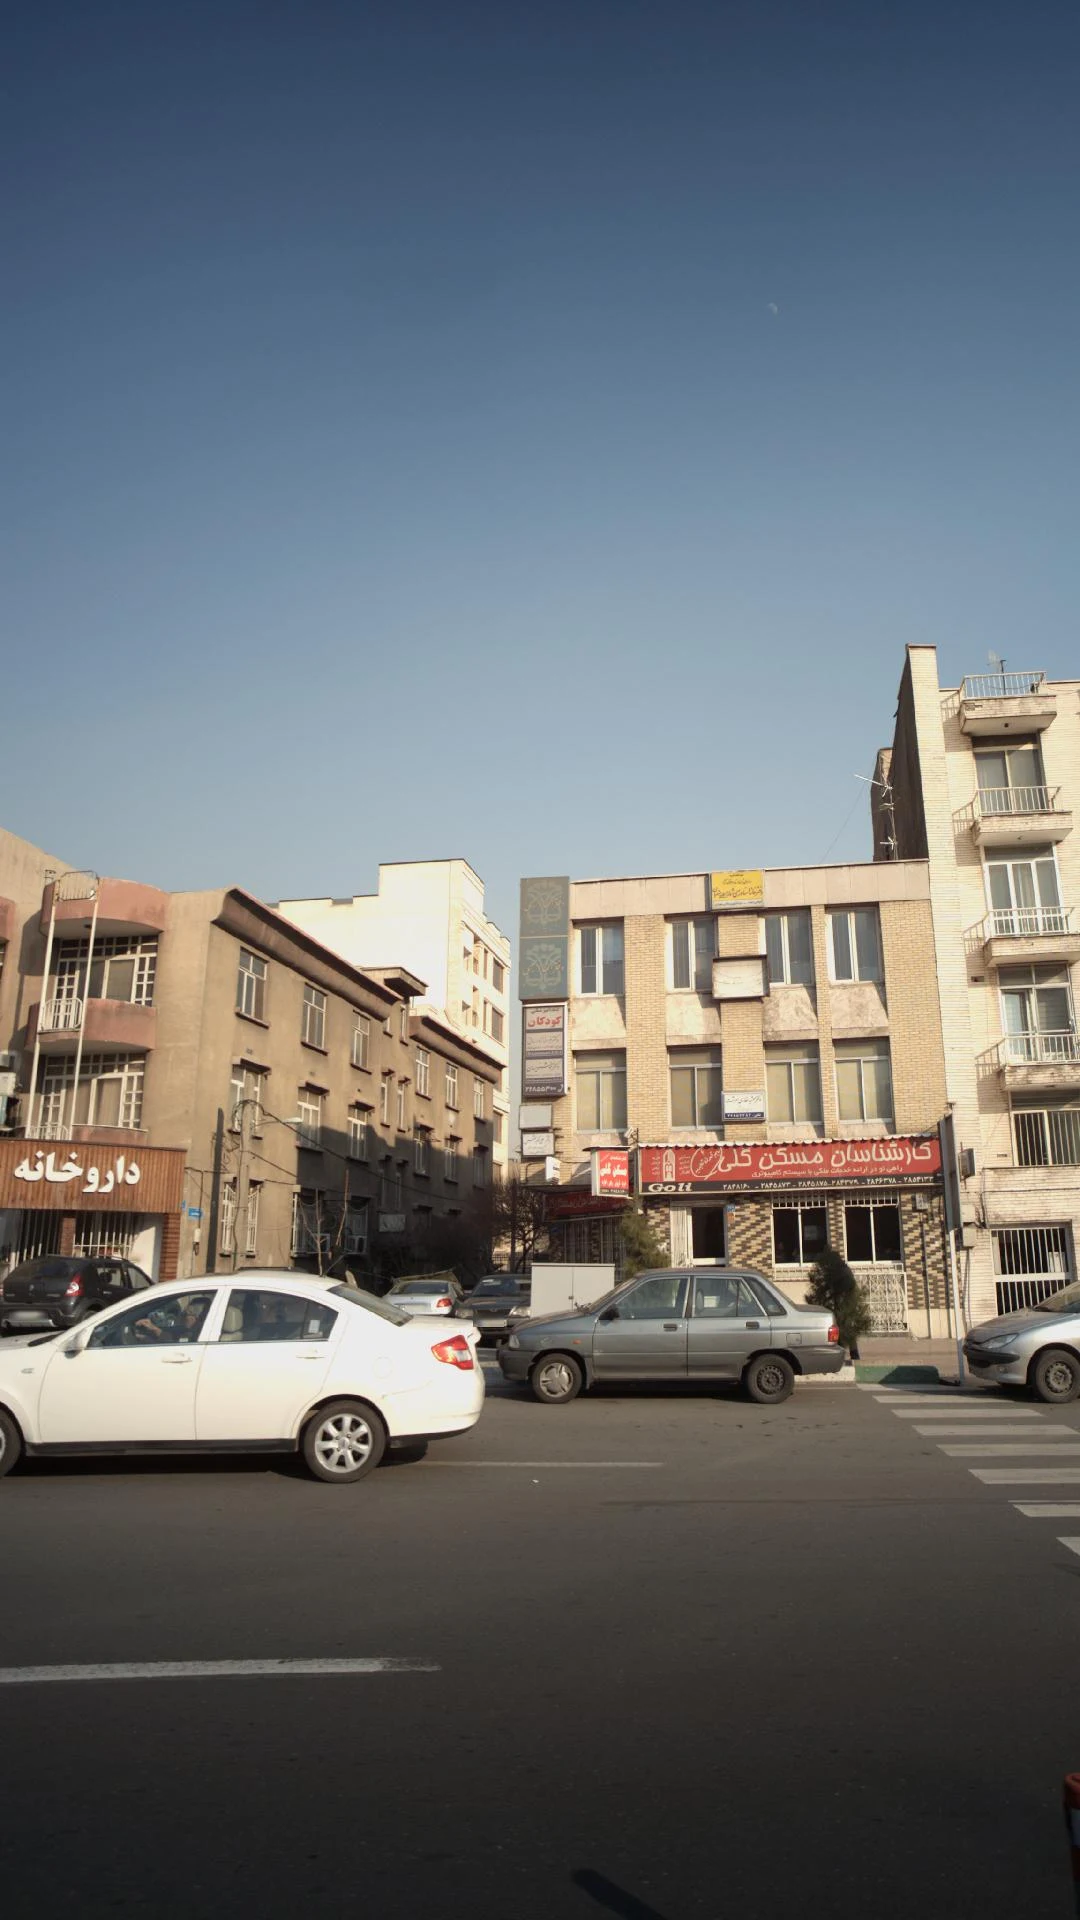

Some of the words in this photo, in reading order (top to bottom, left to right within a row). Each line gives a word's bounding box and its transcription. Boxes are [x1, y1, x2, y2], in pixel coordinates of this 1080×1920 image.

[528, 1015, 562, 1028] کودکان
[718, 1147, 752, 1172] گلی
[758, 1147, 824, 1170] مسکن
[831, 1140, 932, 1167] کارشناسان
[14, 1150, 141, 1193] داروخانه
[648, 1182, 693, 1193] Goli
